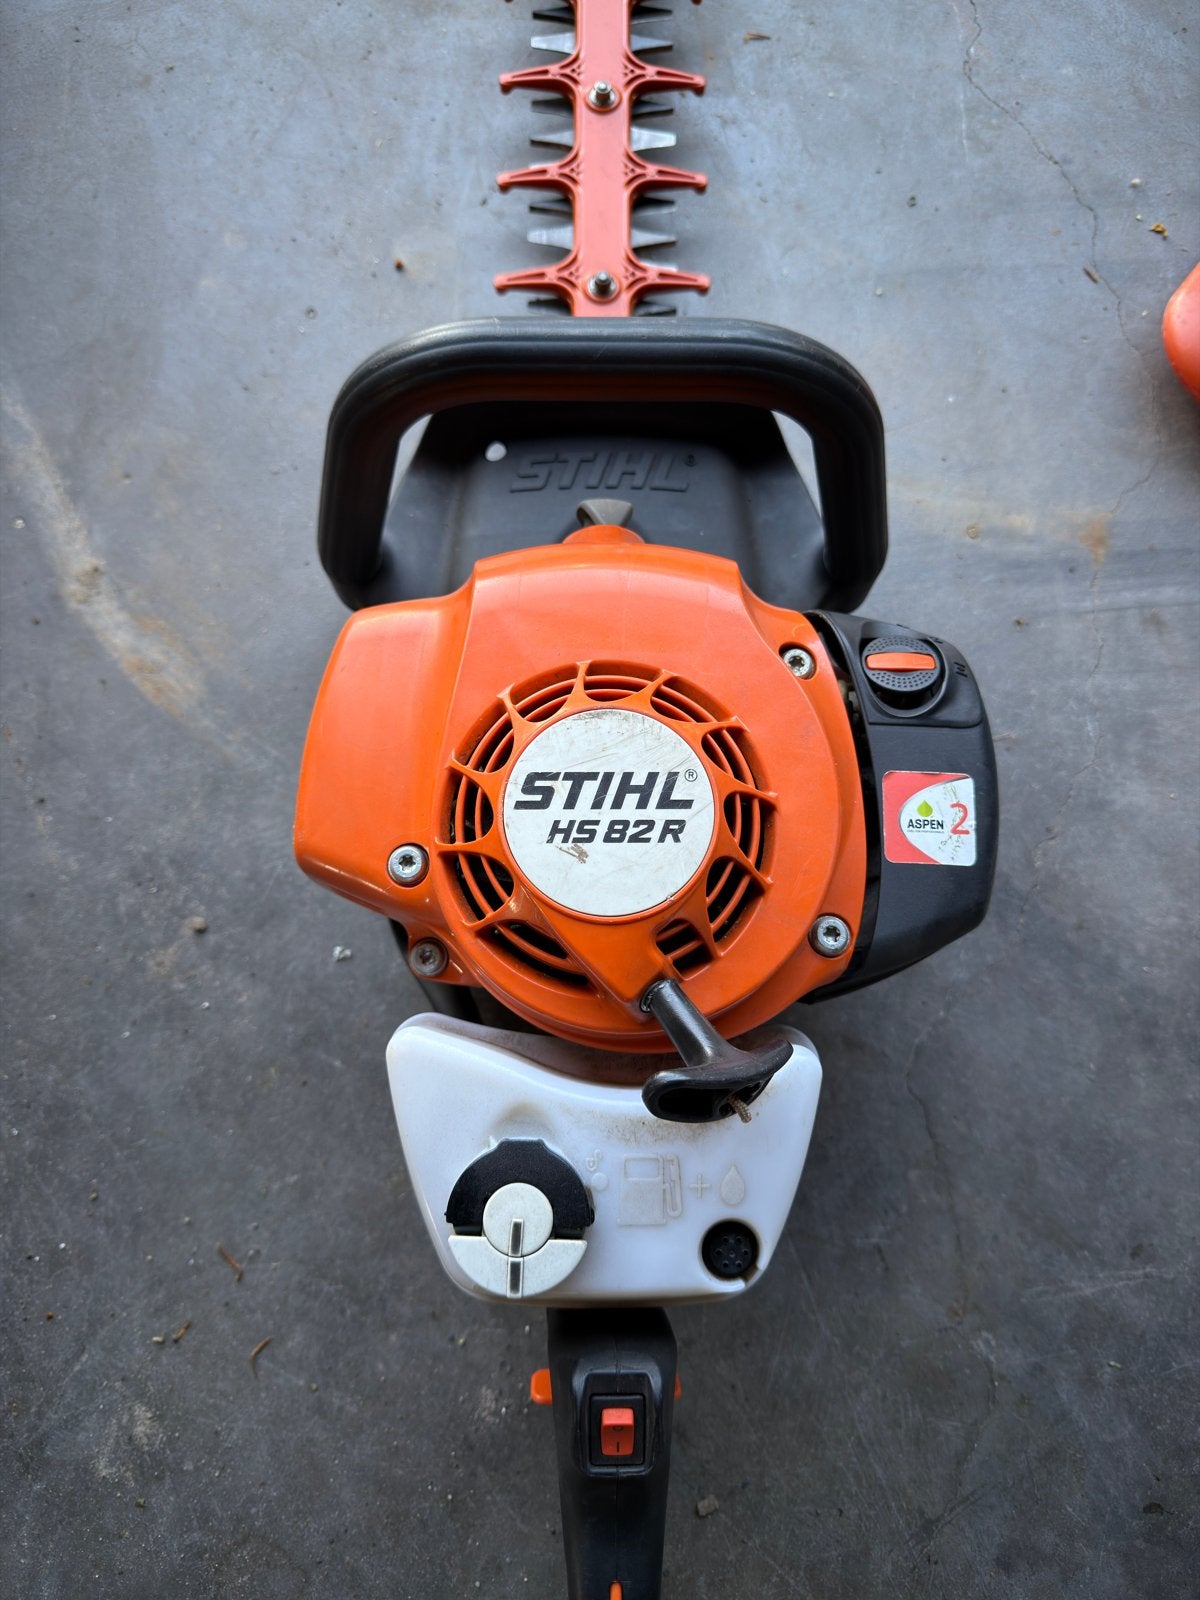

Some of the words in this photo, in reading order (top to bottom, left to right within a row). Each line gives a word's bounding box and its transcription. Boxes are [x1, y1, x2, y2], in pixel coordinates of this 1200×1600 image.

[546, 820, 600, 844] HS
[602, 820, 656, 844] 82
[657, 820, 687, 844] R
[907, 818, 944, 830] ASPEN
[950, 803, 970, 835] 2
